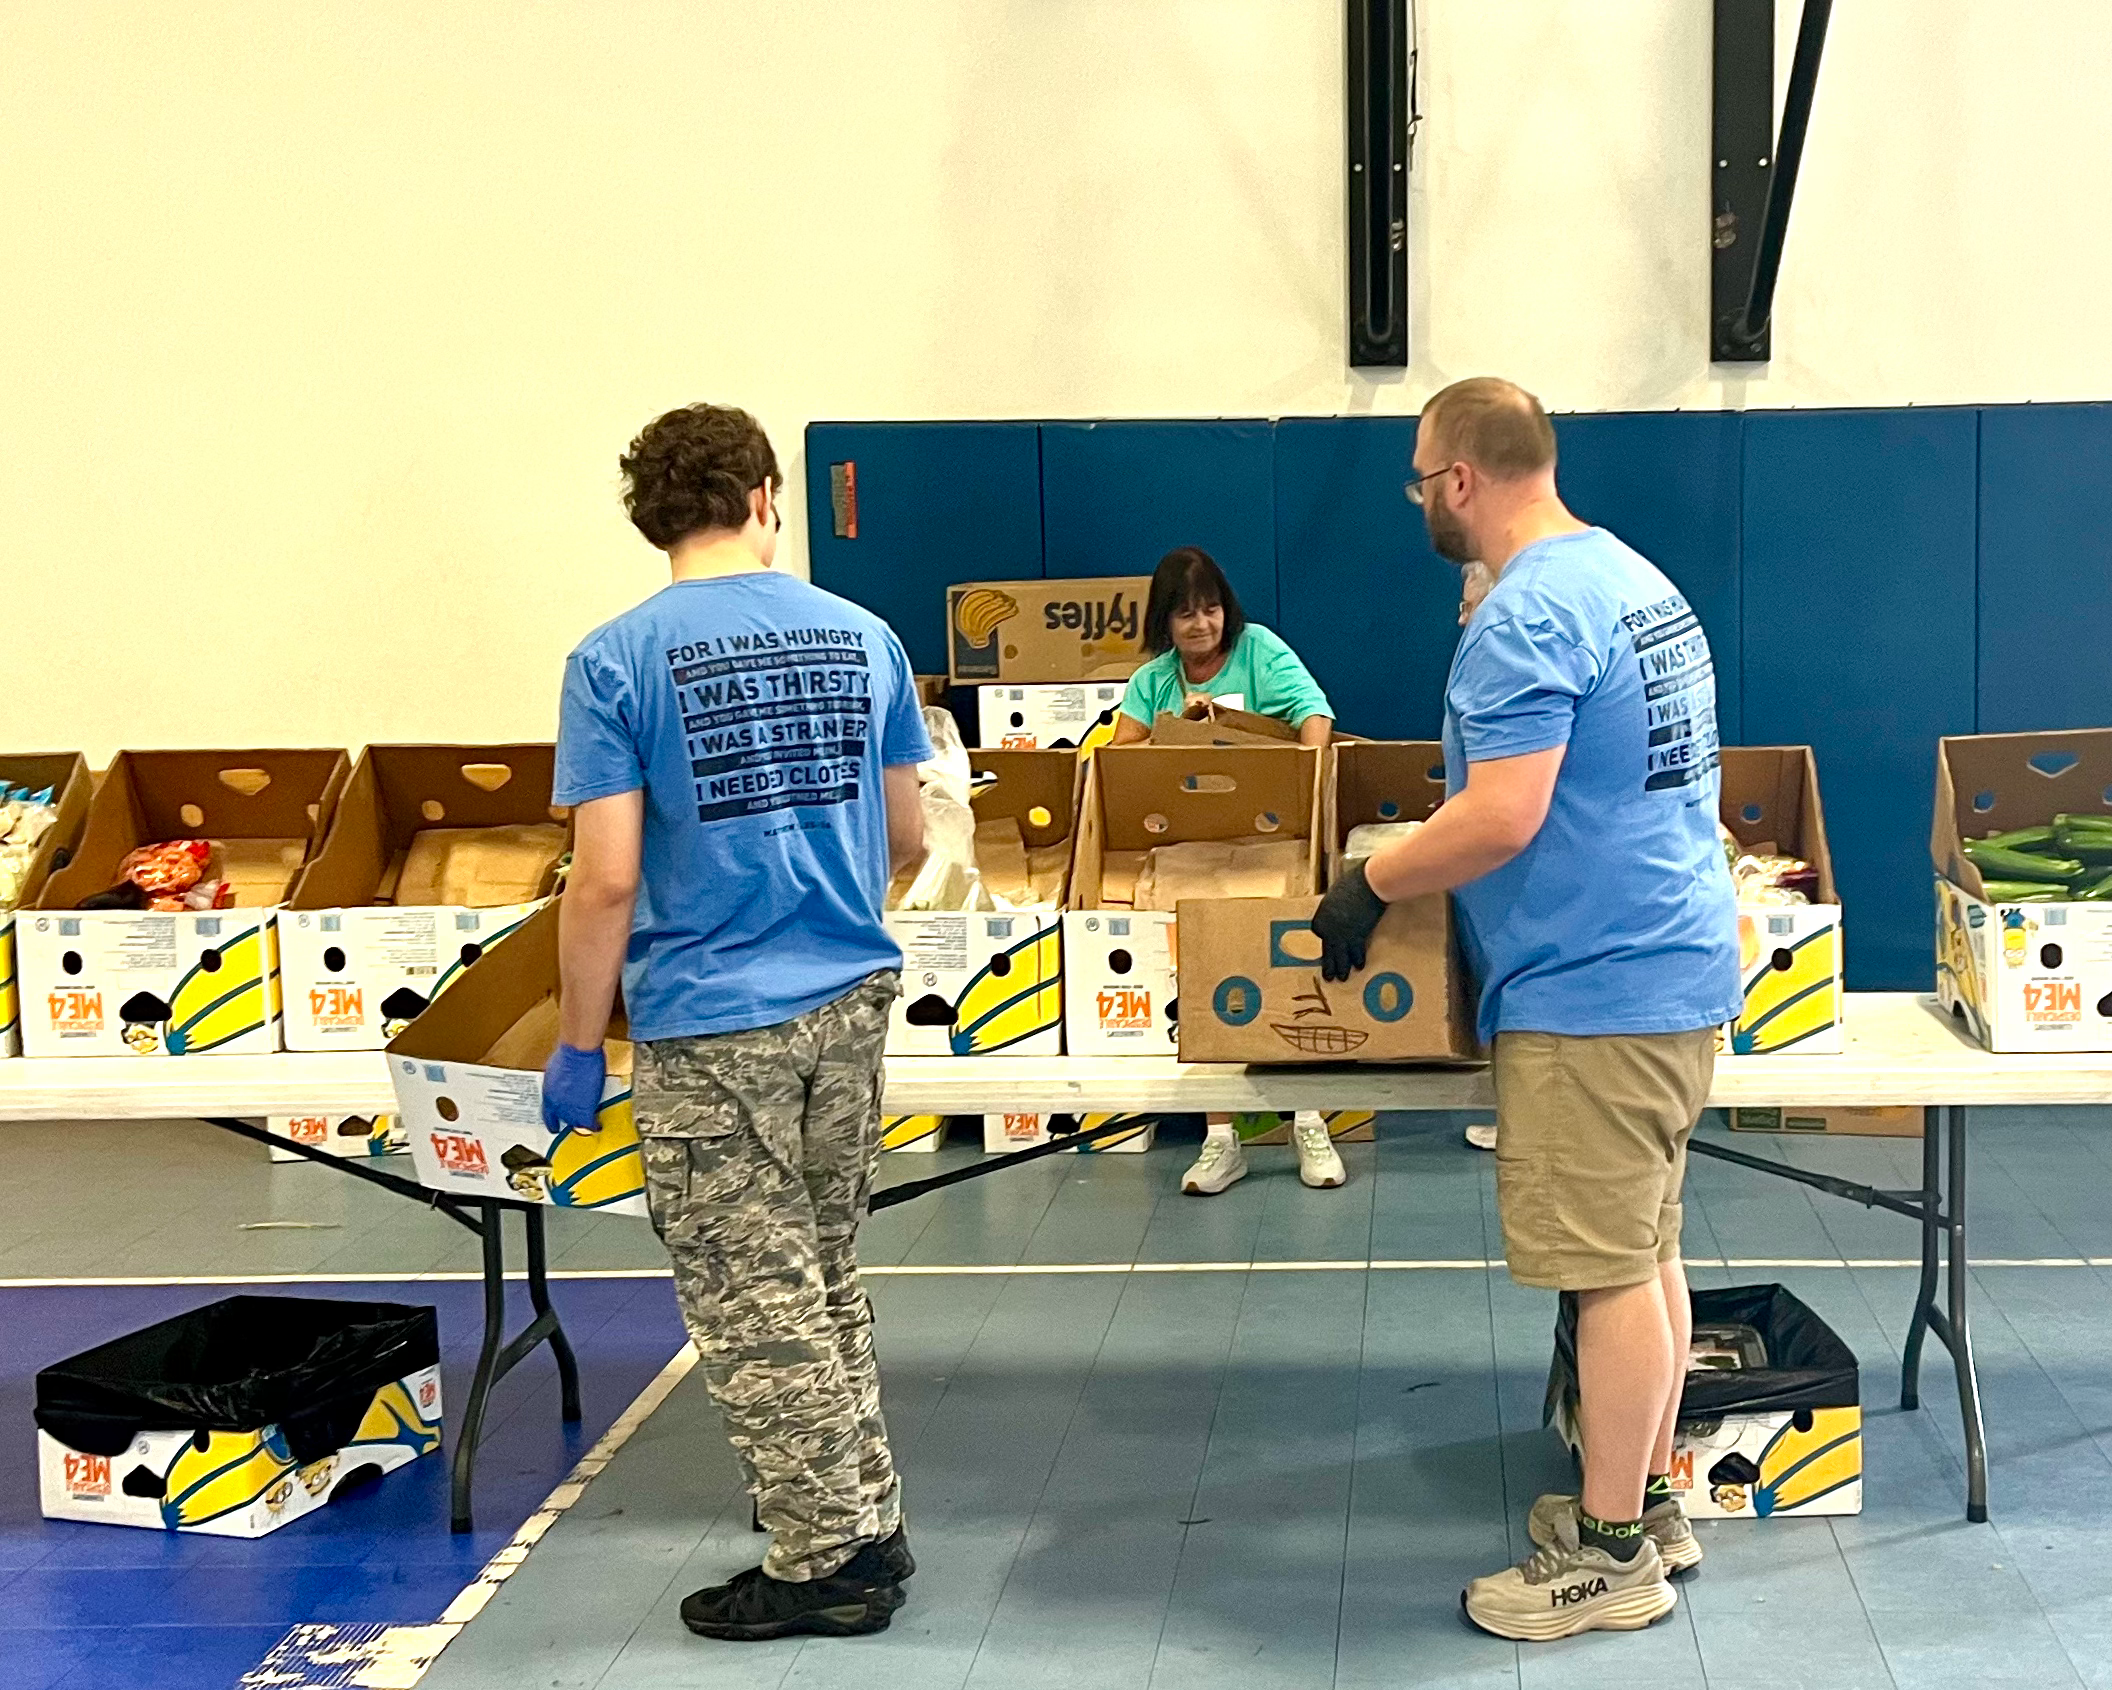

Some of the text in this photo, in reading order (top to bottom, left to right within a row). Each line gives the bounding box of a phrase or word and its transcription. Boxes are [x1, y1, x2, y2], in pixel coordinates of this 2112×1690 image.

[666, 628, 863, 665] FOR I WAS HUNGRY
[1650, 643, 1686, 676] WAS
[678, 671, 870, 714] I WAS THIRSTY
[1657, 696, 1689, 723] WAS
[688, 740, 696, 758] I
[701, 729, 754, 754] WAS
[771, 720, 867, 743] STRANER
[696, 784, 703, 802] I
[789, 761, 860, 786] CLOTES
[1551, 1576, 1608, 1608] HOKA
